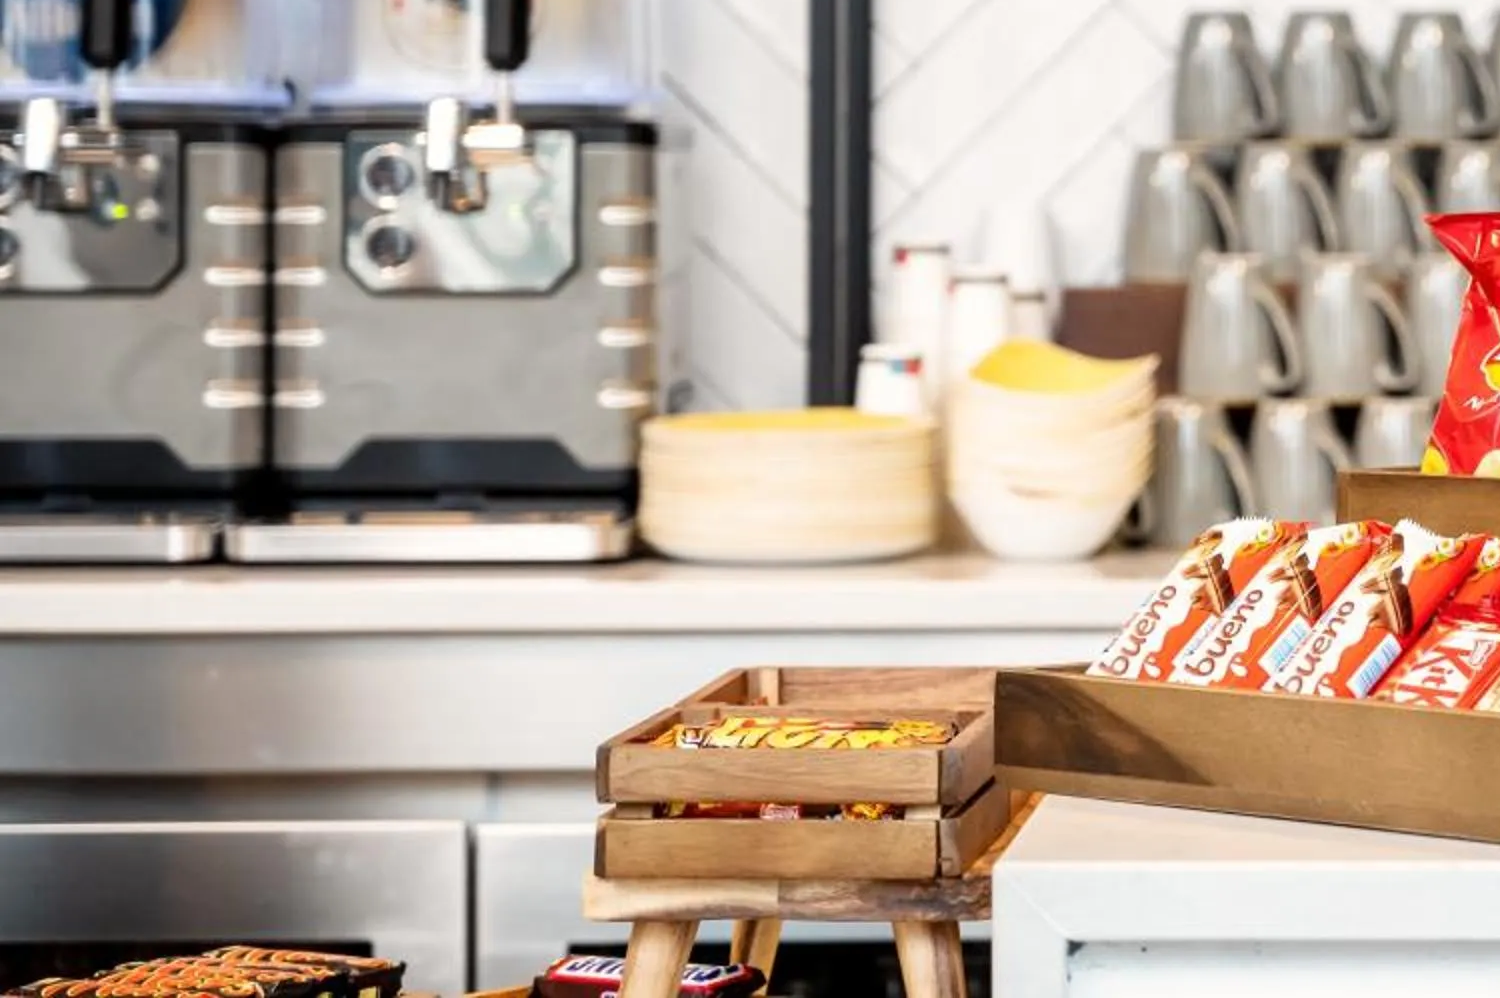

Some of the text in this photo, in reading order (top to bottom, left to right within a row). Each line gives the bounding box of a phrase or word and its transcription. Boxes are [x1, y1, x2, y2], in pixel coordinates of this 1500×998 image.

[1099, 584, 1177, 676] bueno
[1184, 588, 1264, 677] bueno
[1274, 600, 1355, 695] bueno
